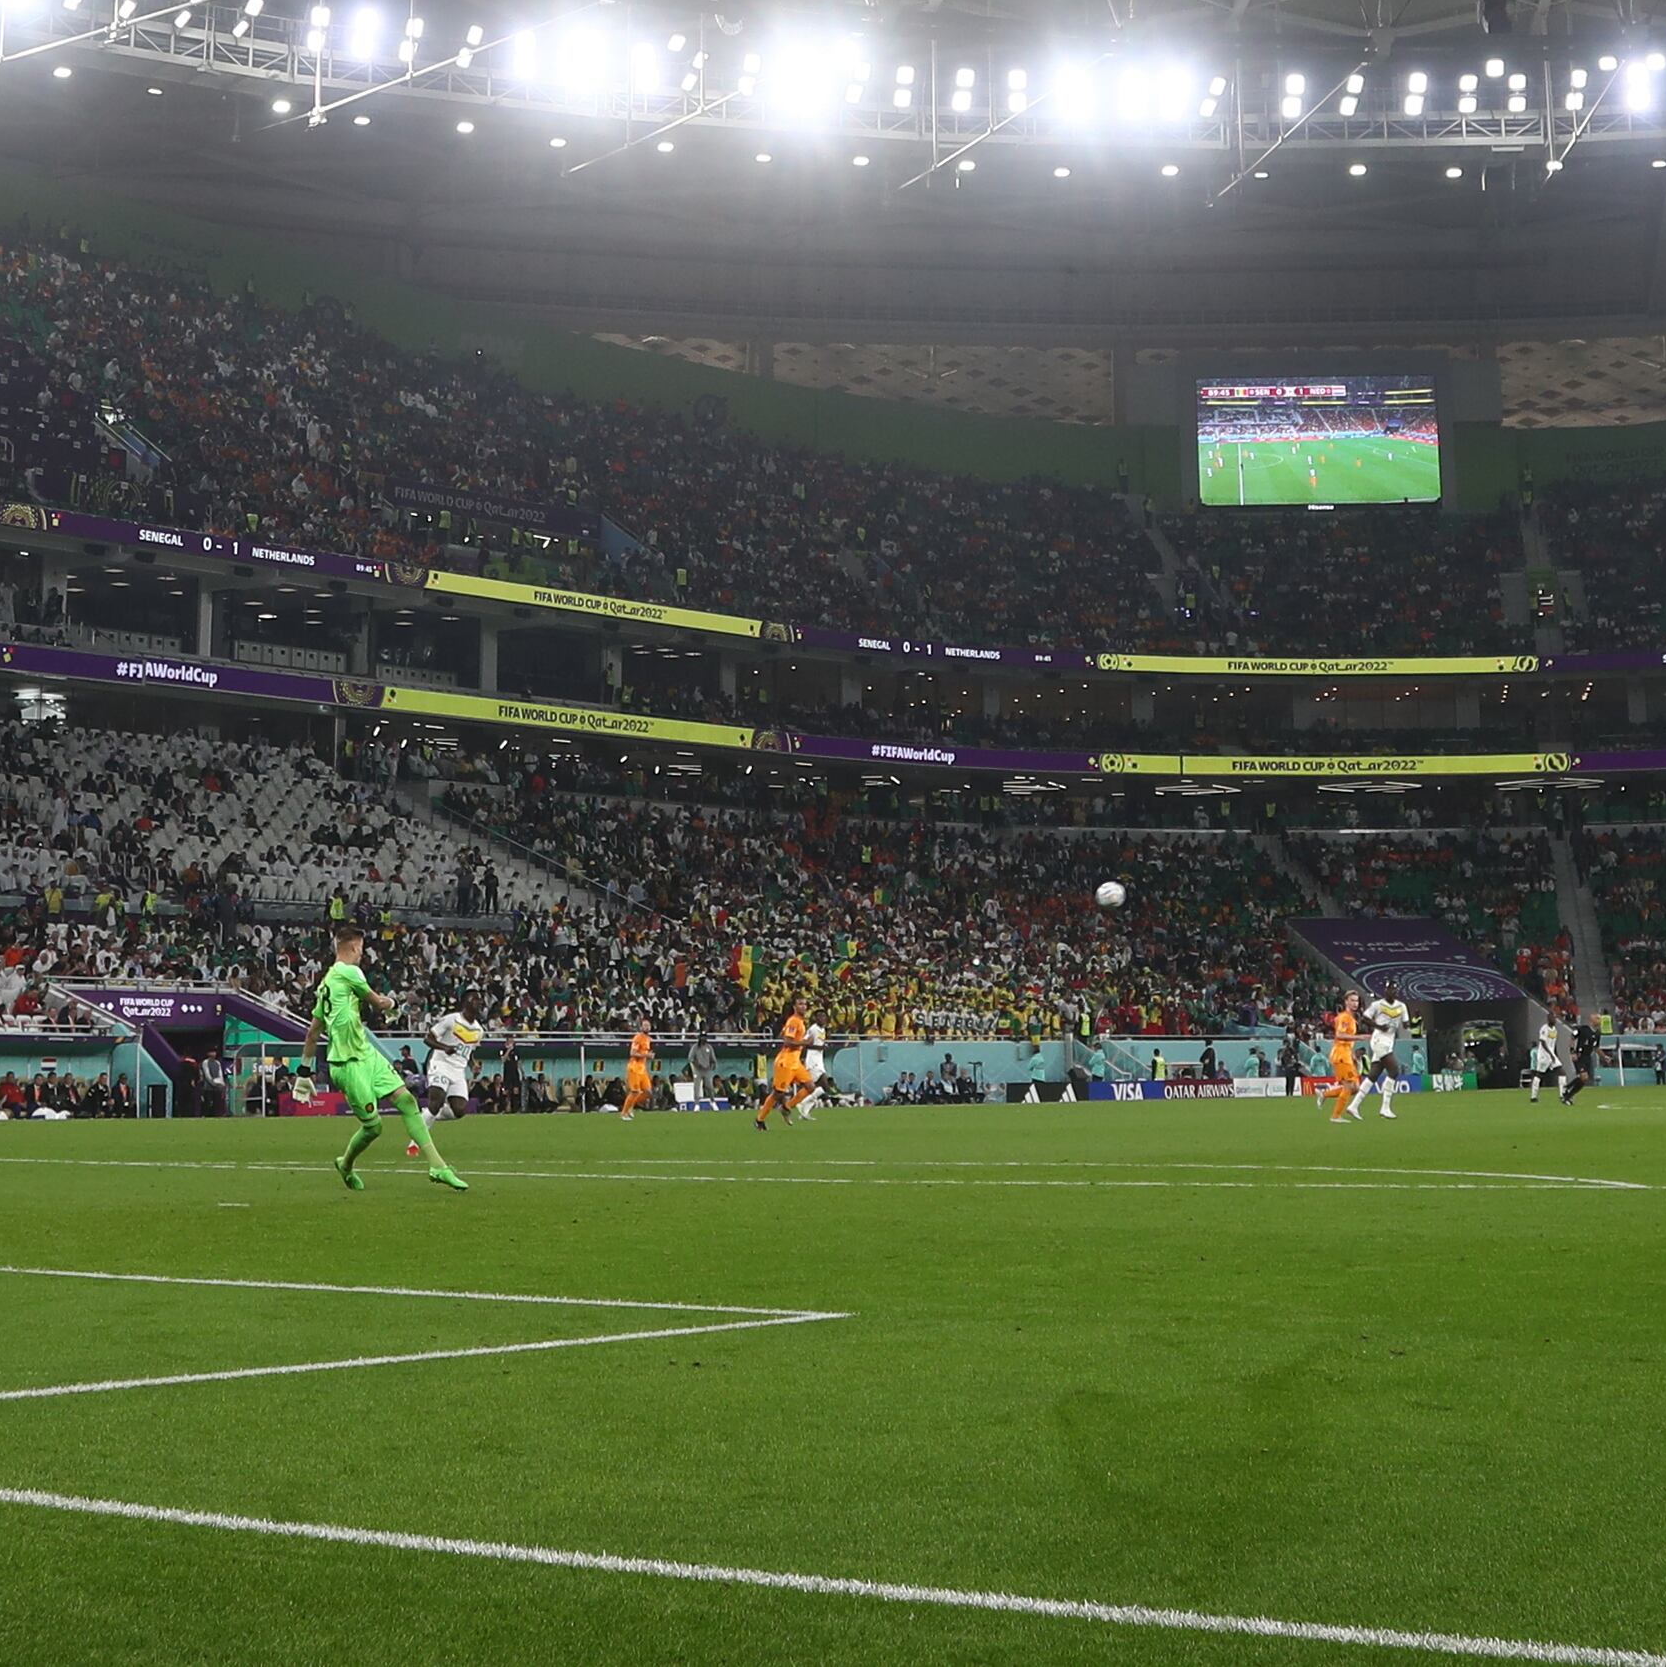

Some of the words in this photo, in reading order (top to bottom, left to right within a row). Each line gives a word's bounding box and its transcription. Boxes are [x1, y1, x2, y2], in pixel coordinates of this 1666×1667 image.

[394, 486, 416, 498] FIFA
[416, 490, 454, 508] WORLD
[455, 497, 474, 510] CUP
[138, 529, 184, 547] SENEGAL
[202, 536, 212, 551] 0
[232, 541, 239, 555] 1
[251, 546, 315, 566] NETHERLANDS
[534, 591, 553, 603] FIFA
[553, 594, 585, 607] WORLD
[585, 599, 602, 610] CUP
[858, 638, 891, 651] SENEGAL
[902, 641, 910, 653] 0
[926, 644, 932, 655] 1
[944, 647, 1000, 660] NETHERLANDS
[1227, 661, 1250, 671] FIFA
[1251, 661, 1288, 671] WORLD
[1289, 662, 1309, 671] CUP
[498, 705, 520, 718] FIFA
[521, 708, 558, 723] WORLD
[558, 712, 578, 725] CUP
[871, 744, 956, 765] #FIFAWorldCup
[1232, 760, 1257, 771] FIFA
[1257, 760, 1301, 771] WORLD
[1302, 761, 1325, 771] CUP
[119, 997, 135, 1007] FIFA
[135, 998, 160, 1007] WORLD
[160, 998, 174, 1007] CUP
[1110, 1083, 1144, 1101] VISA
[1164, 1085, 1196, 1099] QATAR
[1197, 1084, 1234, 1098] AIRWAYS
